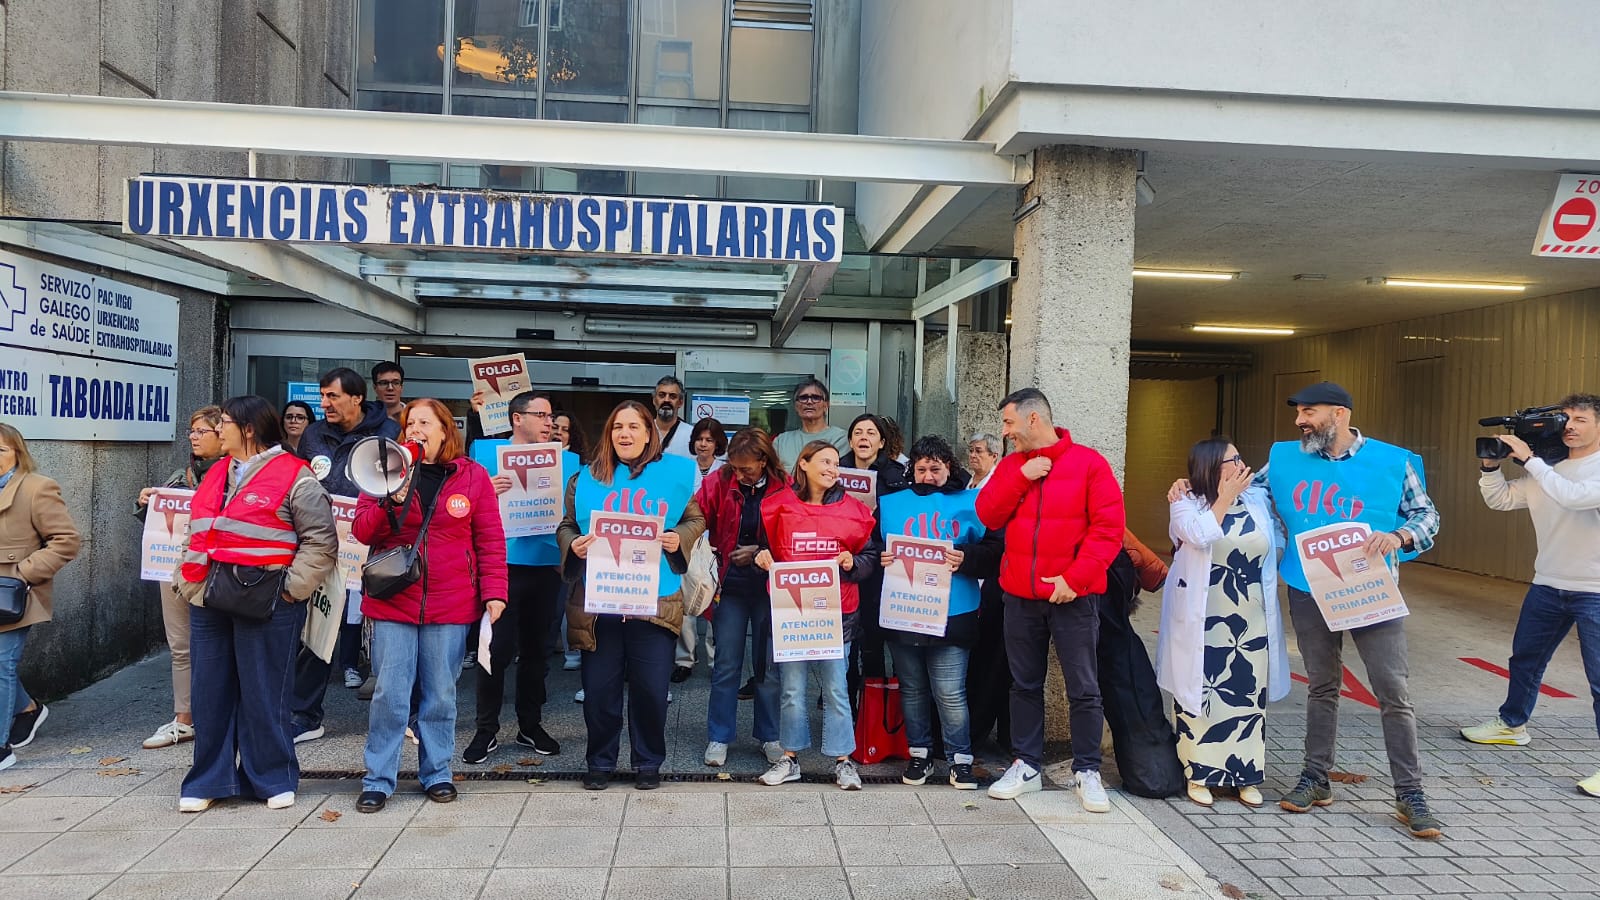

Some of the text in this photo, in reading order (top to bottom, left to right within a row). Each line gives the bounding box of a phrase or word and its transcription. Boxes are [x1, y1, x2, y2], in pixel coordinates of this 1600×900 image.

[1575, 180, 1600, 194] ZO
[128, 180, 836, 261] URXENCIAS EXTRAHOSPITALARIAS
[40, 273, 91, 300] SERVIZO
[98, 288, 132, 310] PAC VIGO
[40, 297, 90, 322] GALEGO
[97, 310, 140, 332] URXENCIAS
[30, 318, 90, 344] de SAÚDE
[96, 332, 172, 358] EXTRAHOSPITALARIAS
[478, 364, 520, 376] FOLGA
[49, 374, 170, 422] TABOADA LEAL
[485, 400, 510, 410] ATEN
[508, 453, 554, 467] FOLGA
[836, 478, 868, 490] OLGA
[159, 498, 192, 510] FOLG
[332, 506, 356, 520] OLG
[508, 510, 555, 520] PRIMARIA
[601, 522, 654, 537] FOLGA
[150, 544, 182, 552] ATENC
[1308, 532, 1364, 555] FOLGA
[896, 546, 944, 560] FOLGA
[780, 572, 830, 585] FOLGA
[596, 584, 649, 596] PRIMARIA
[1331, 591, 1390, 613] PRIMARIA
[890, 604, 939, 616] PRIMARIA
[783, 632, 834, 642] PRIMARIA
